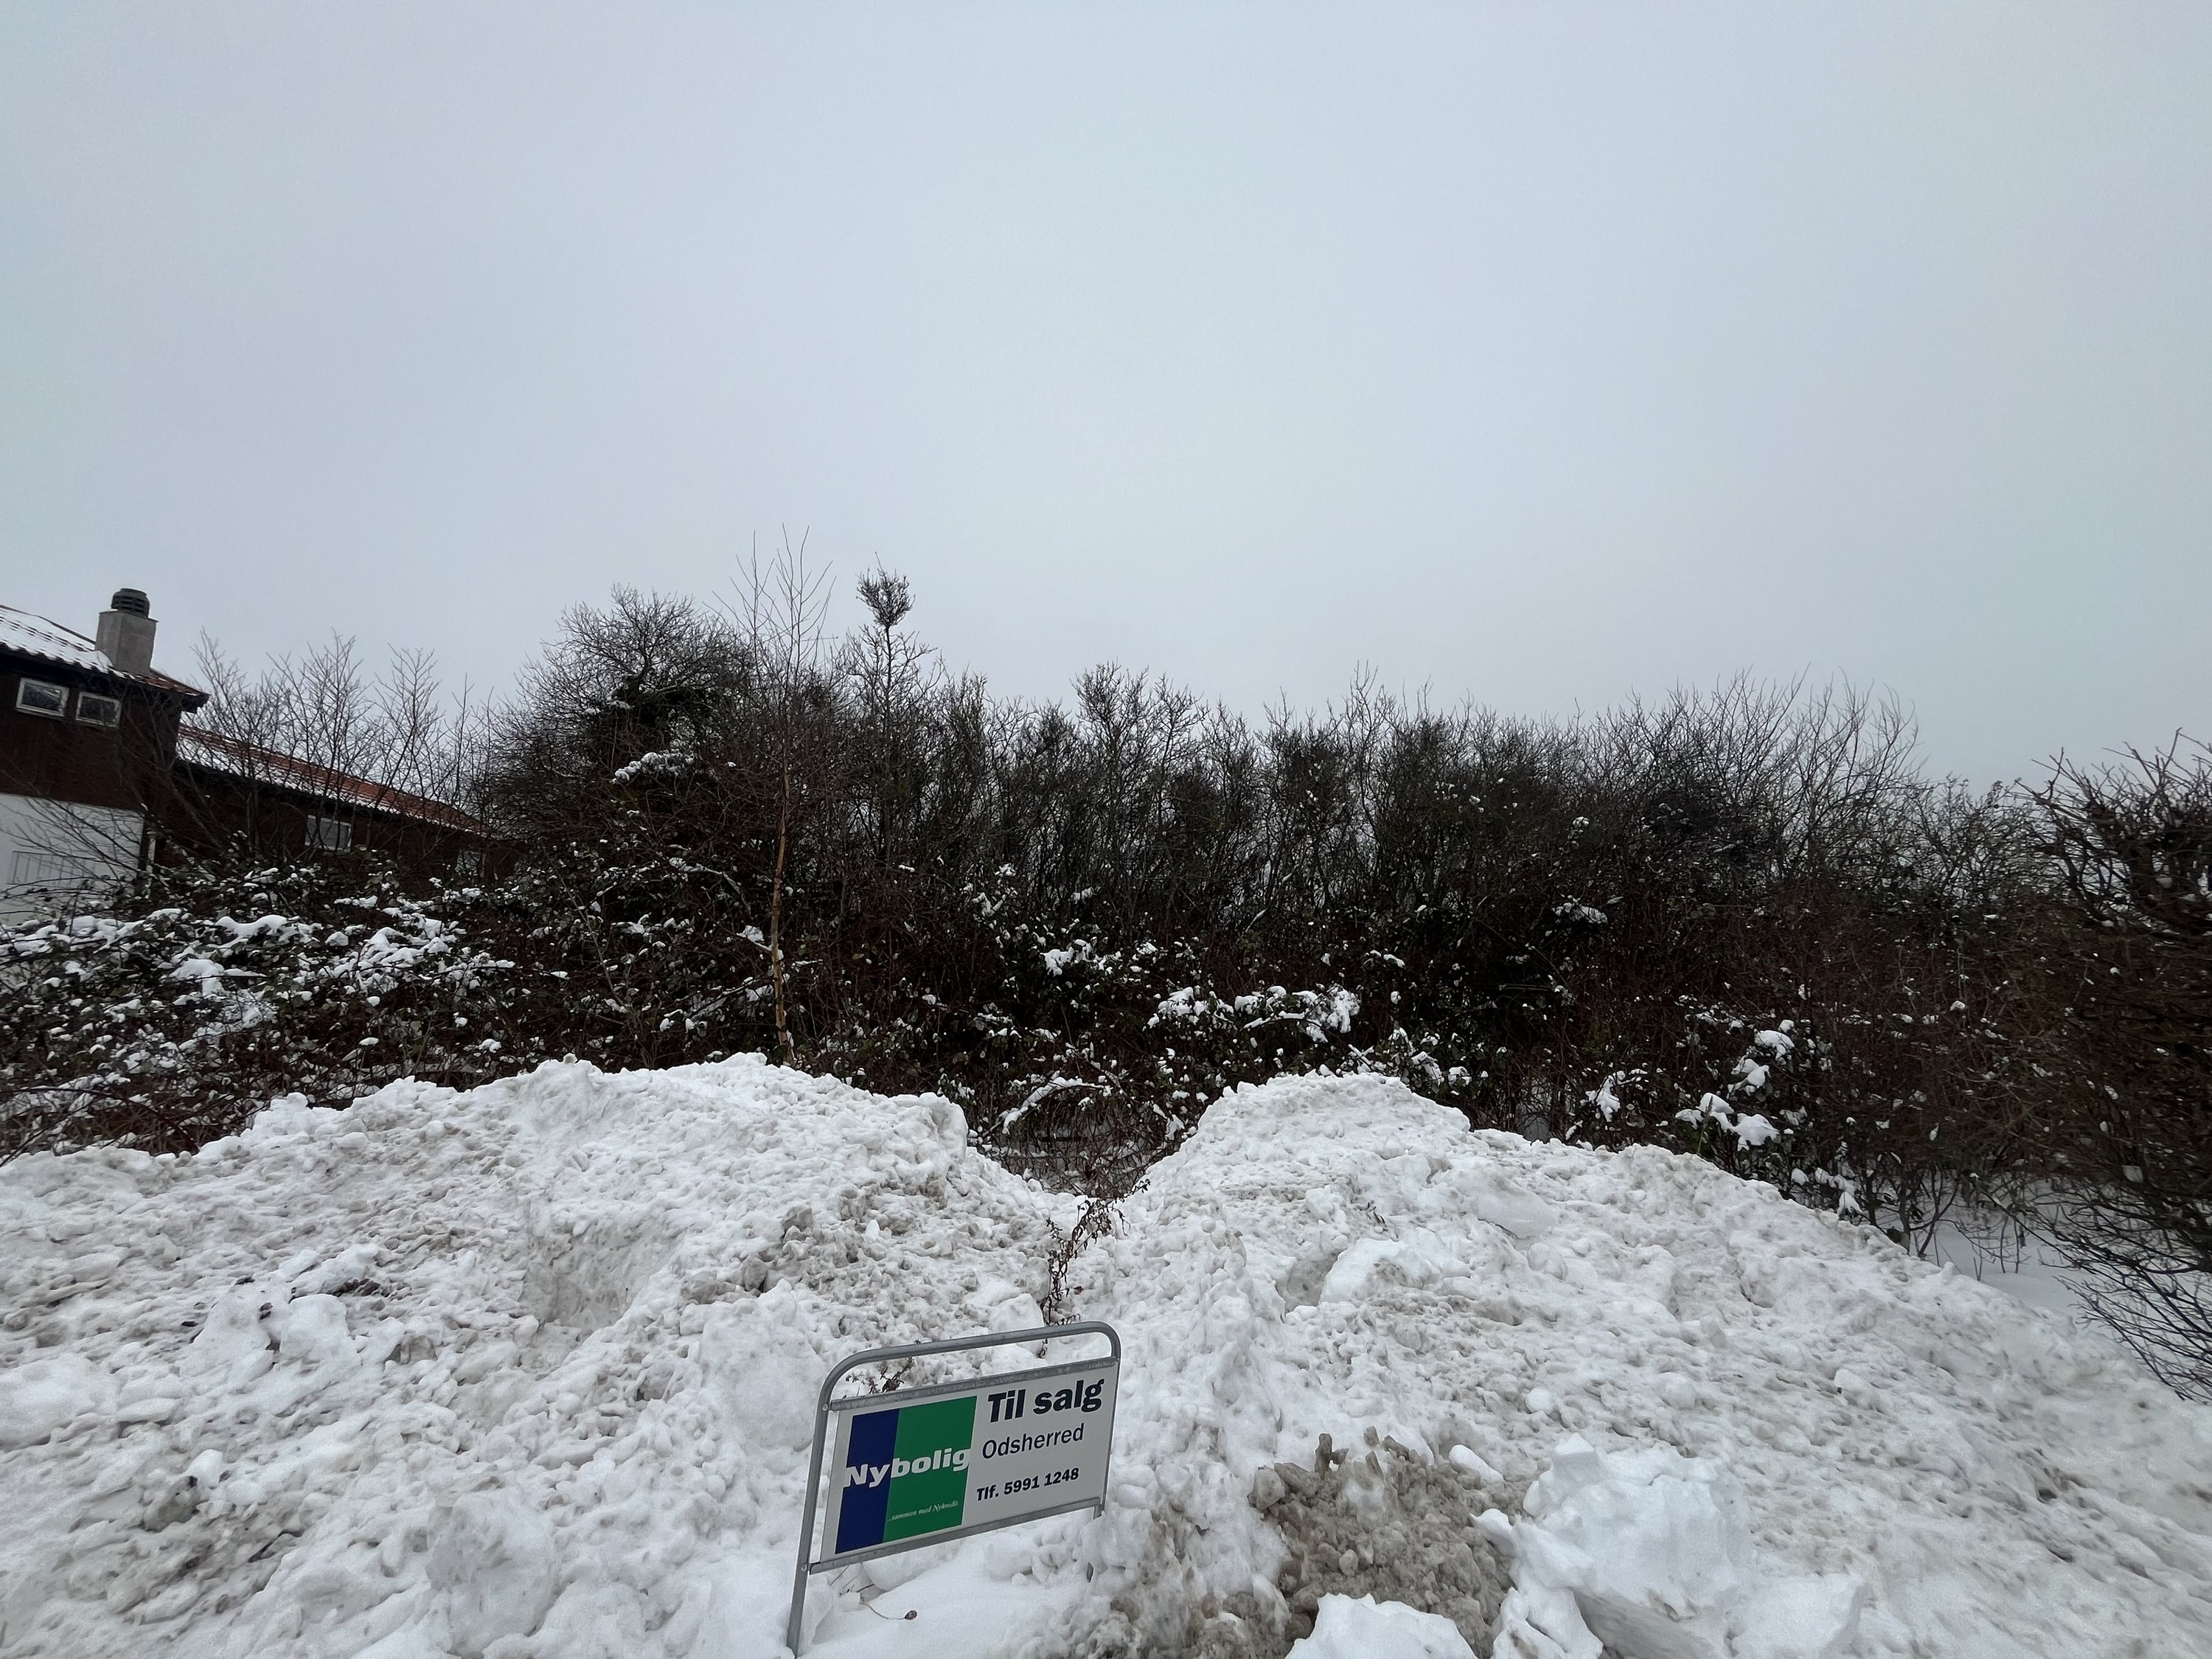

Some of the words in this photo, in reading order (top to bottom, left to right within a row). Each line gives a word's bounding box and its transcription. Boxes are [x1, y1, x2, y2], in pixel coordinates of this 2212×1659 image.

[988, 1389, 1026, 1423] Til
[1033, 1379, 1105, 1413] salg
[982, 1423, 1085, 1459] Odsherred
[844, 1447, 972, 1488] Nybolig
[977, 1484, 999, 1501] Tlf.
[1004, 1475, 1040, 1495] 5991
[1043, 1467, 1079, 1486] 1248
[919, 1506, 932, 1514] med
